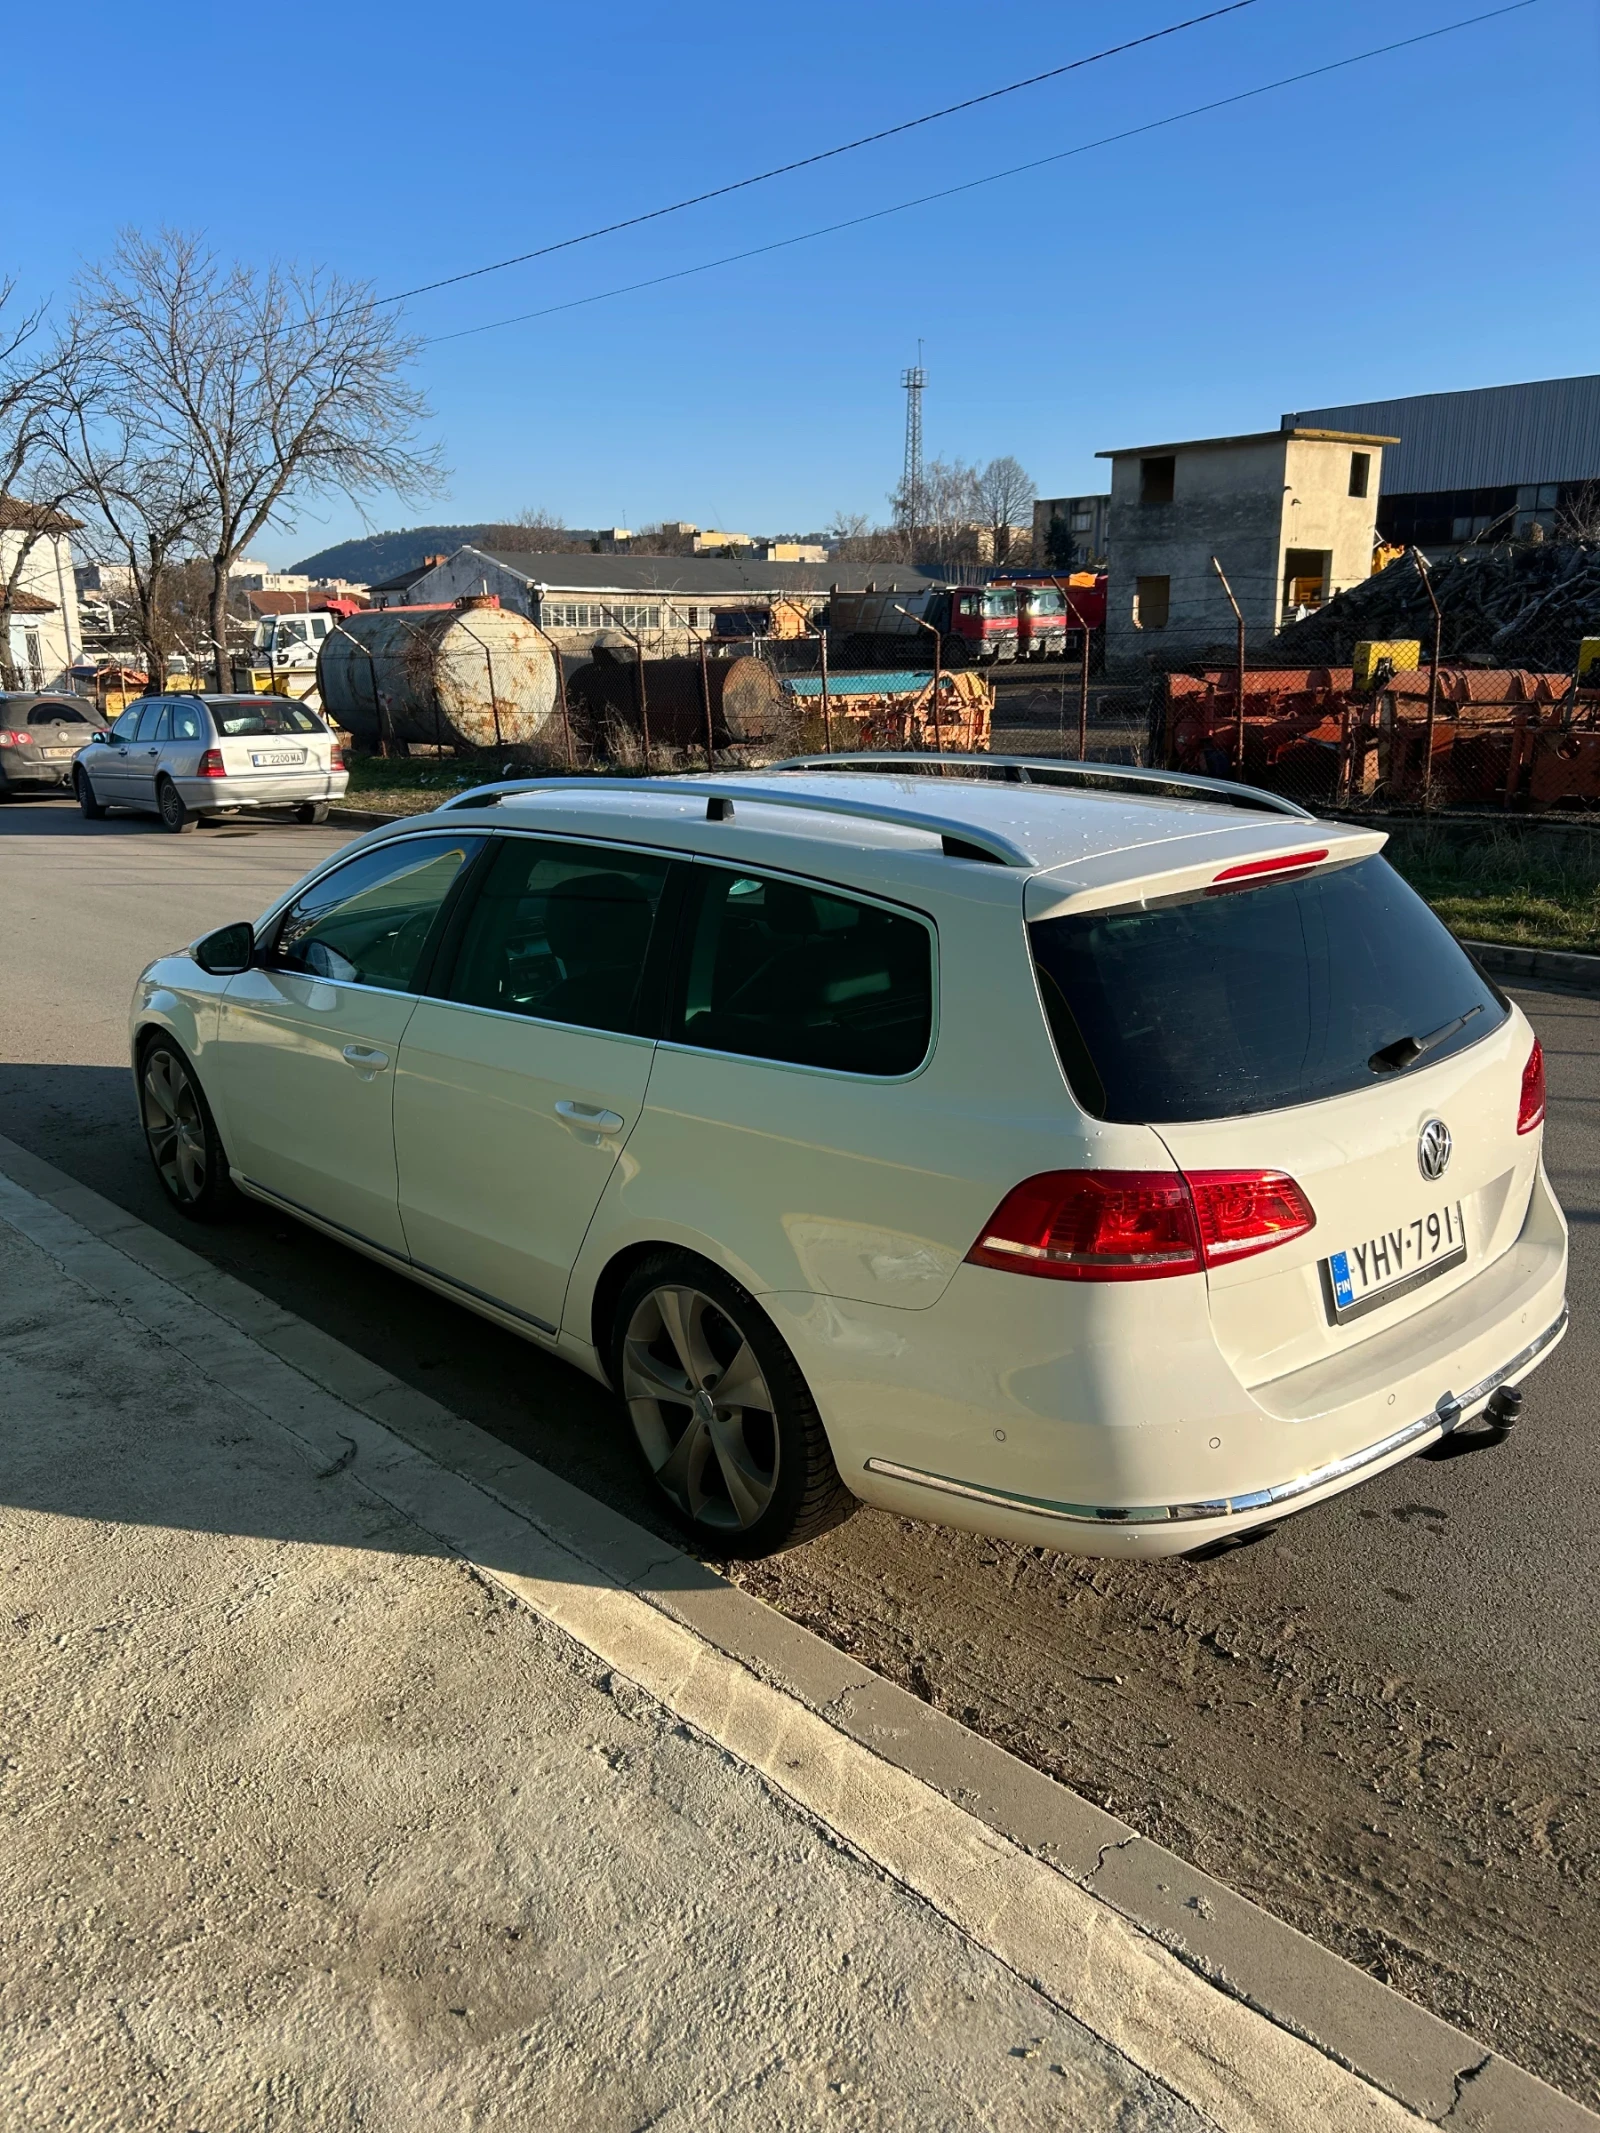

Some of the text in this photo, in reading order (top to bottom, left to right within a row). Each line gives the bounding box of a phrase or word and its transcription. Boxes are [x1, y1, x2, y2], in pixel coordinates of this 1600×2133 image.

[270, 754, 290, 763] 2200
[1352, 1205, 1453, 1287] YHV-791
[1336, 1278, 1351, 1296] FIN
